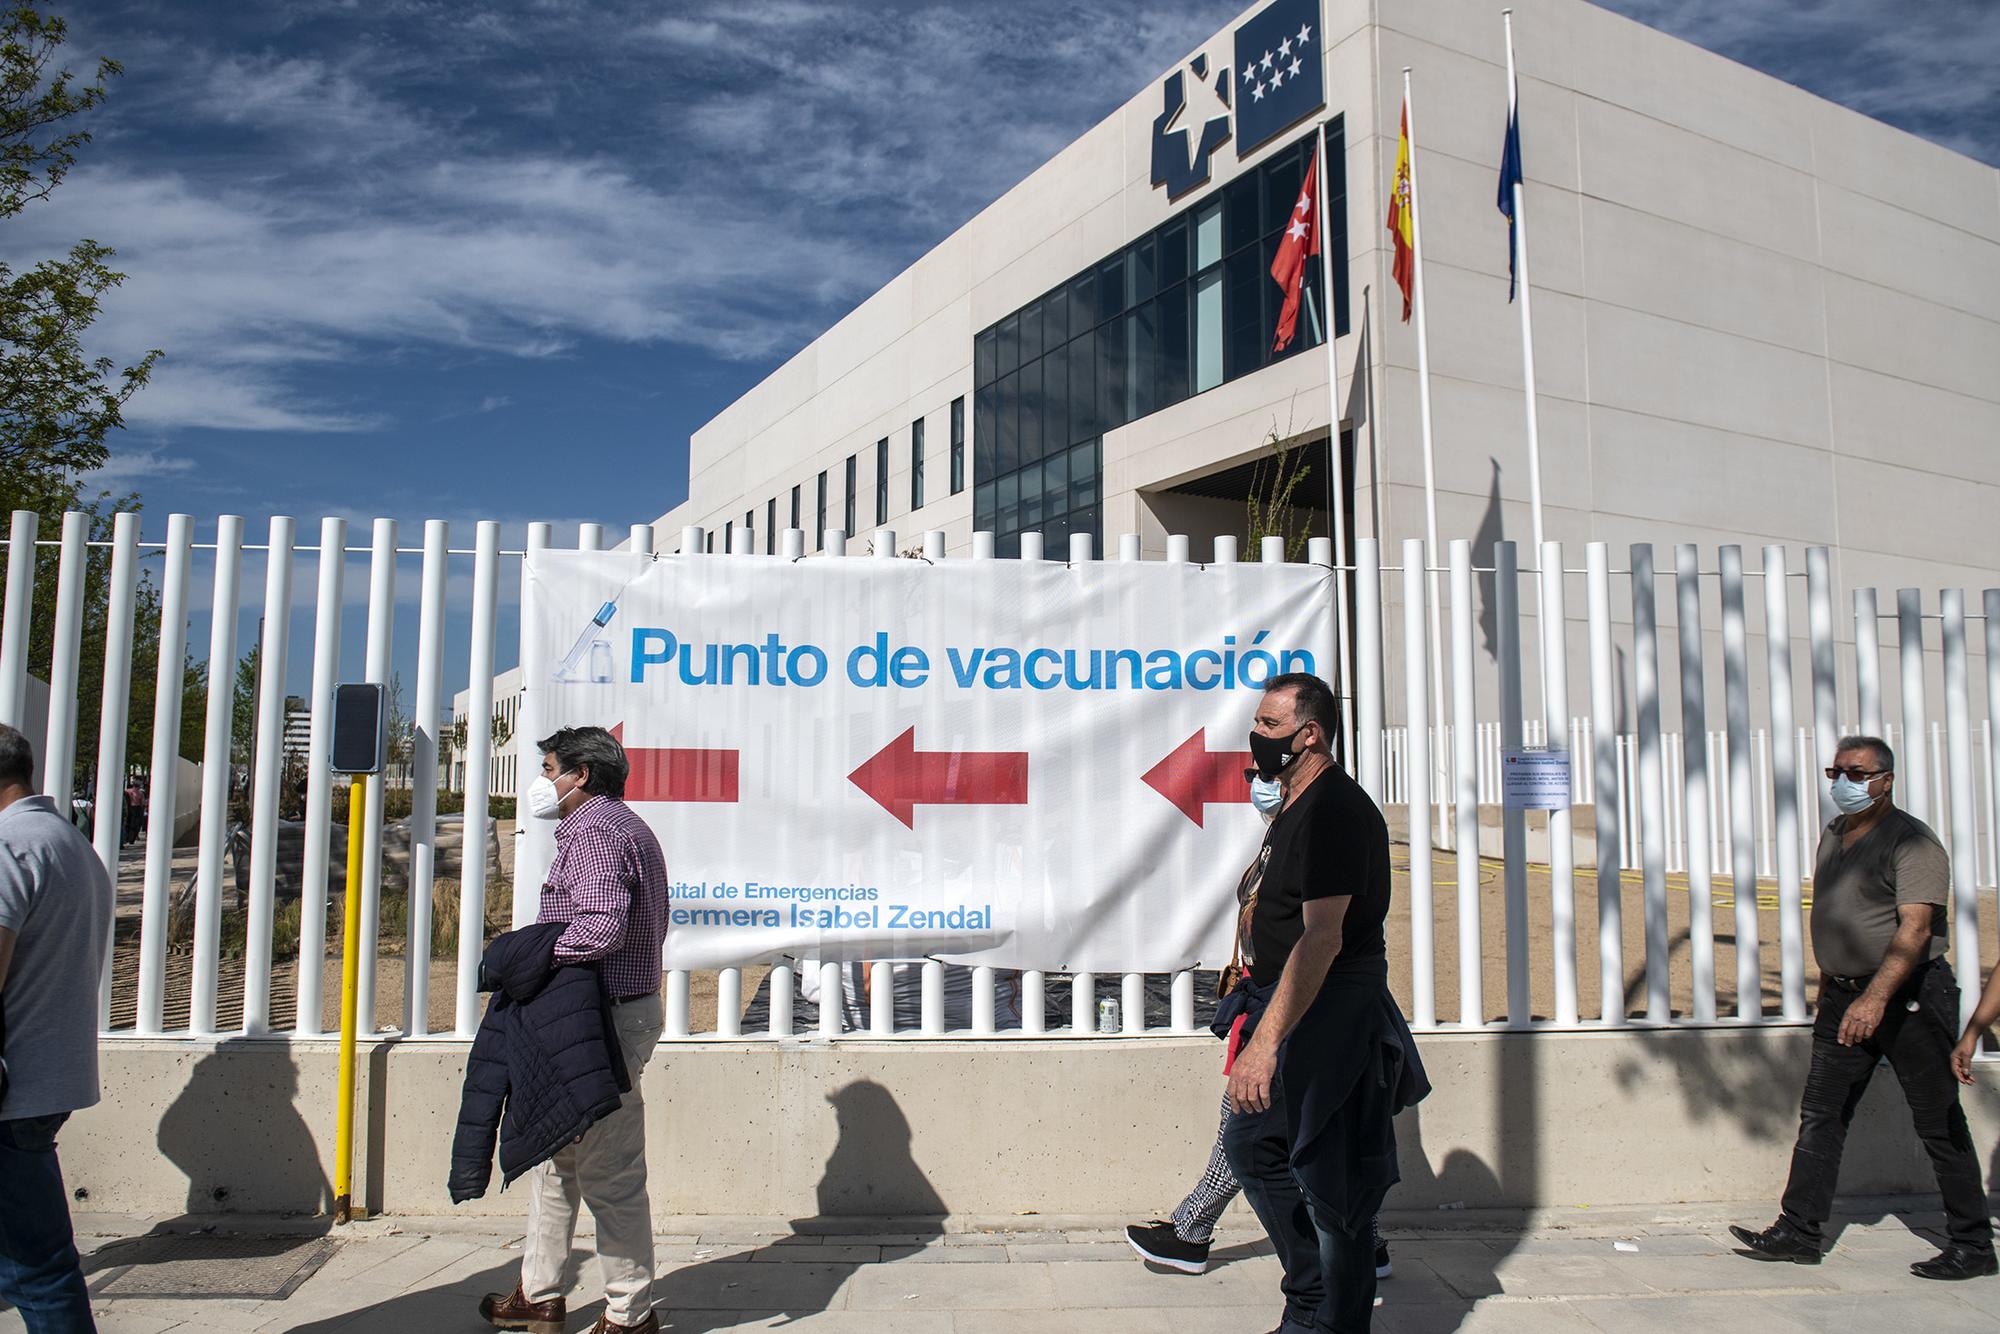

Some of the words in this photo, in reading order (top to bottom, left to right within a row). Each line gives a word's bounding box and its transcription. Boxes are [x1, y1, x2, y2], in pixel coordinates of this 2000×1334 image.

[630, 627, 828, 688] Punto
[846, 632, 930, 689] de
[945, 631, 1316, 691] vacunación
[668, 882, 706, 899] pital
[712, 882, 738, 899] de
[745, 882, 878, 903] Emergencias
[671, 908, 780, 928] ermera
[791, 904, 878, 929] Isabel
[887, 905, 991, 929] Zendal
